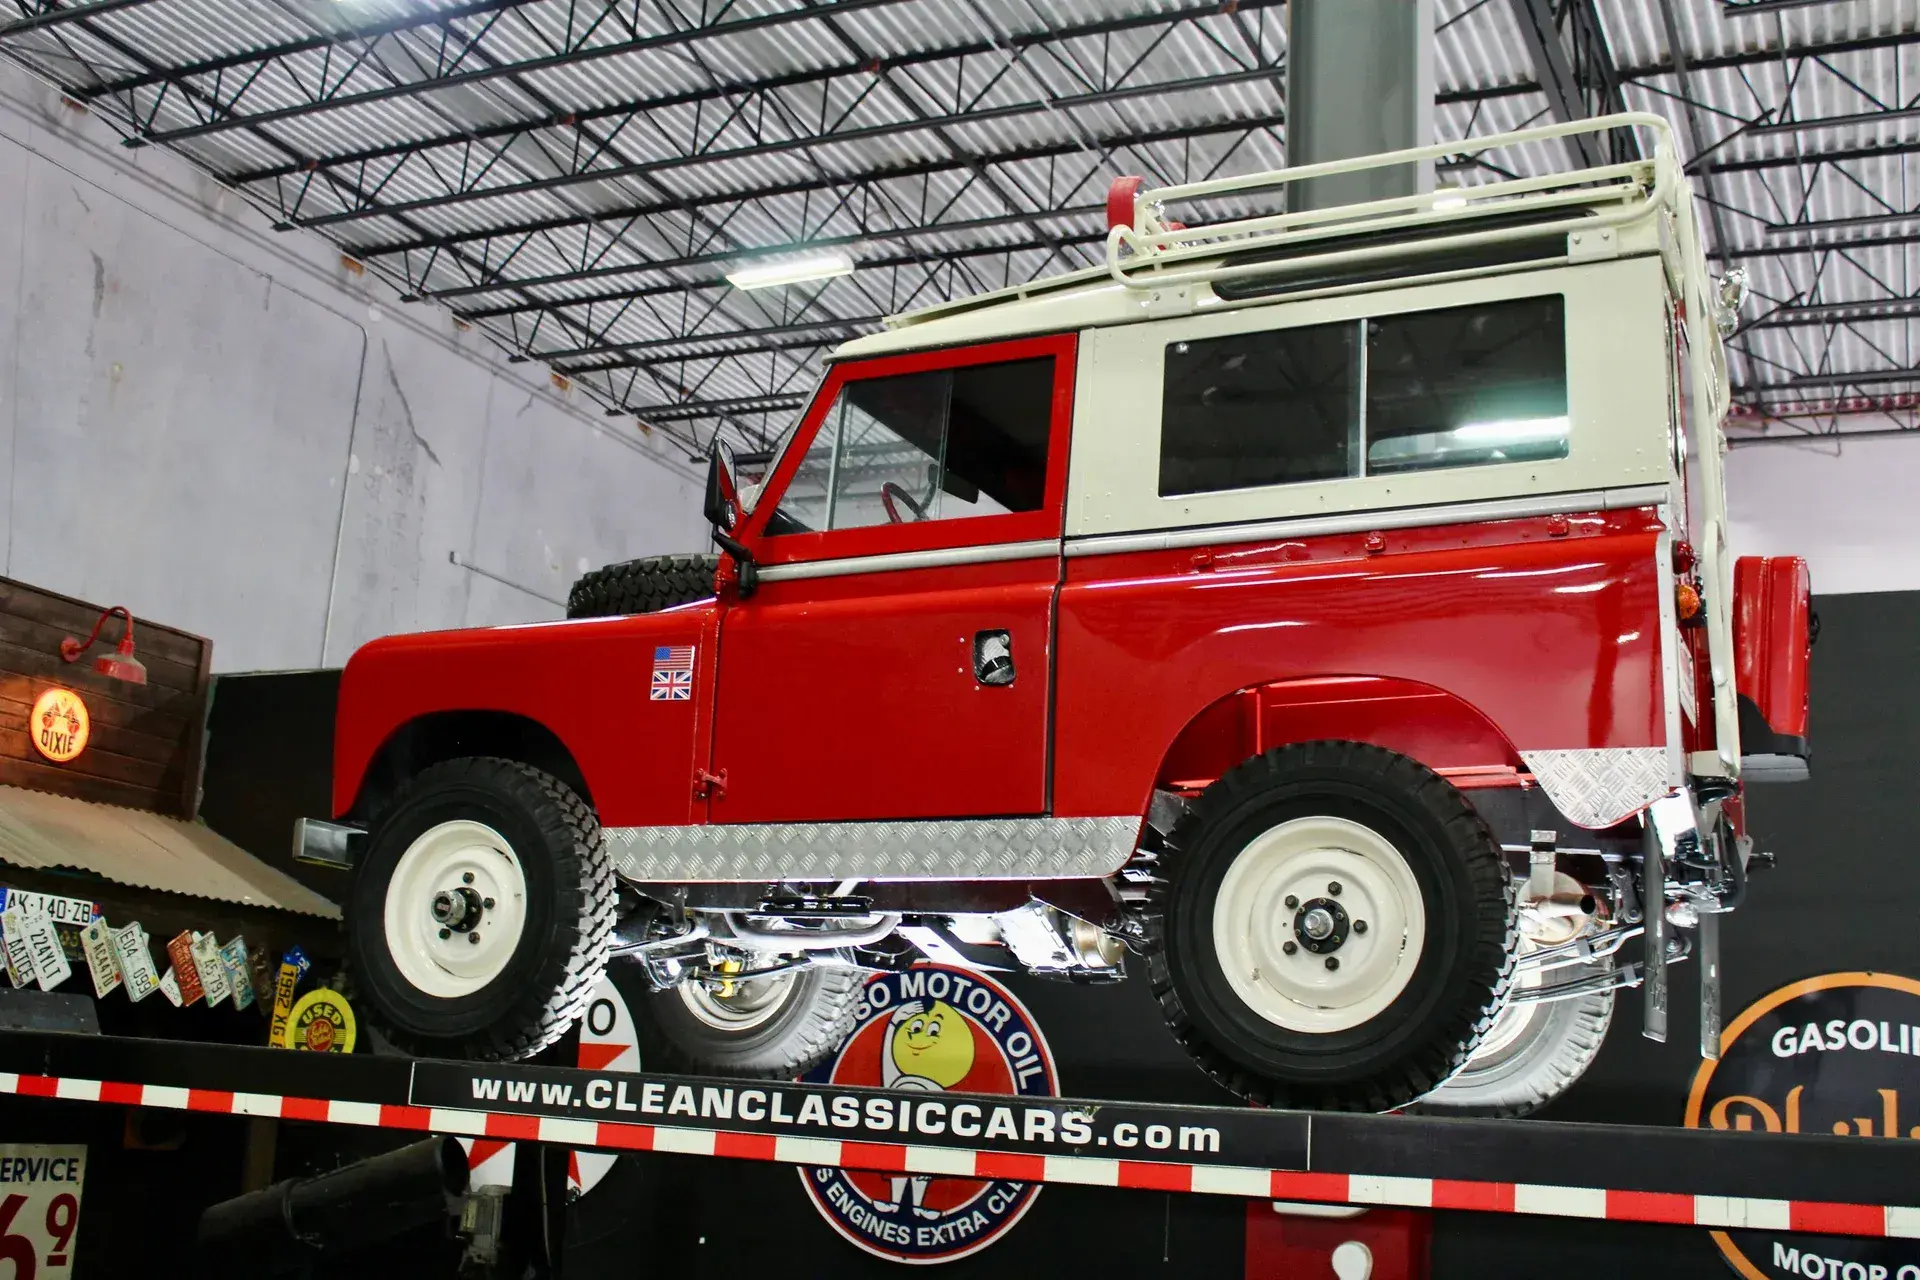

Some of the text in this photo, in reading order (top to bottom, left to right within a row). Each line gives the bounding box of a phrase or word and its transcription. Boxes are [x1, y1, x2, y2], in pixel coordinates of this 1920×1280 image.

[41, 729, 75, 755] DIXIE
[31, 928, 61, 979] 224YLT
[277, 970, 294, 1009] 1992
[302, 1004, 341, 1025] USED
[900, 971, 1012, 1033] MOTOR
[1006, 1031, 1043, 1090] OIL
[471, 1077, 1221, 1152] www.CLEANCLASSICCARS.com
[0, 1157, 80, 1183] ERVICE
[825, 1182, 911, 1245] ENGINES
[917, 1212, 989, 1246] EXTRA
[1773, 1241, 1888, 1280] MOTOR
